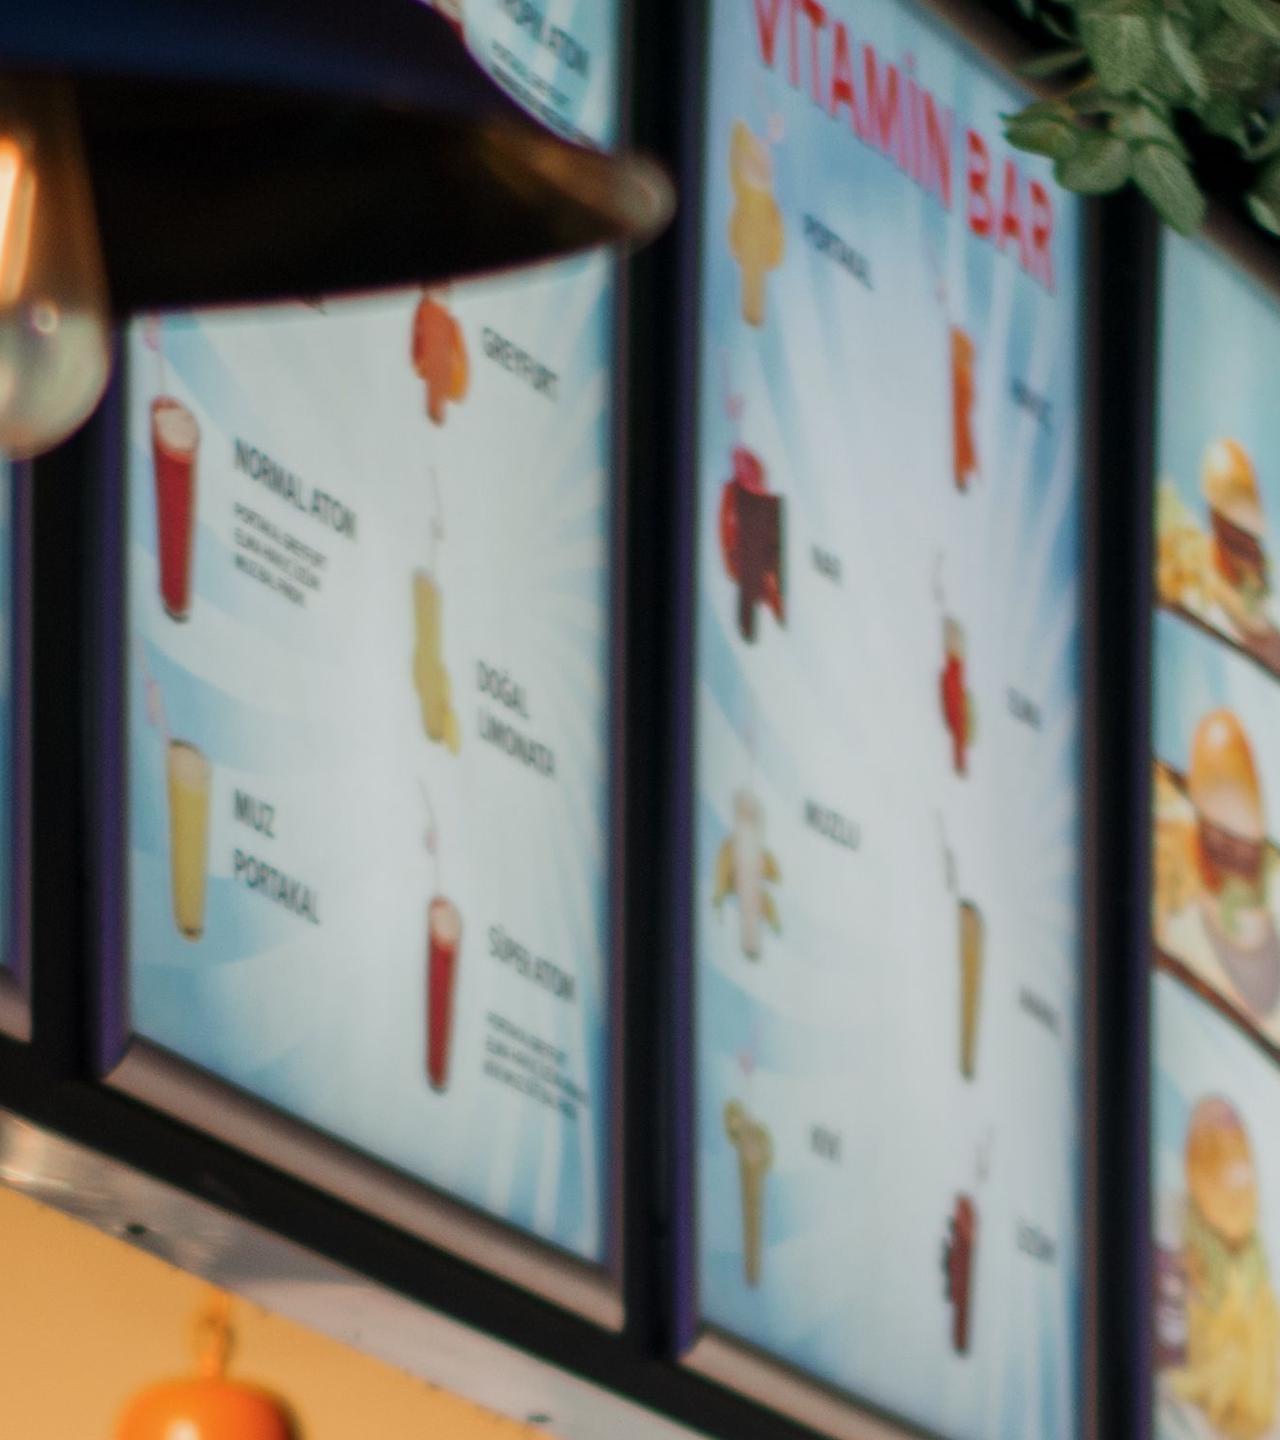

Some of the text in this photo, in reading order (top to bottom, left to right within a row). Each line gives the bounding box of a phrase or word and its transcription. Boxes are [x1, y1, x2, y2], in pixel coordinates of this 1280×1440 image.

[966, 127, 1057, 296] BAR
[234, 788, 275, 838] MUZ
[234, 847, 321, 926] PORTAKAL
